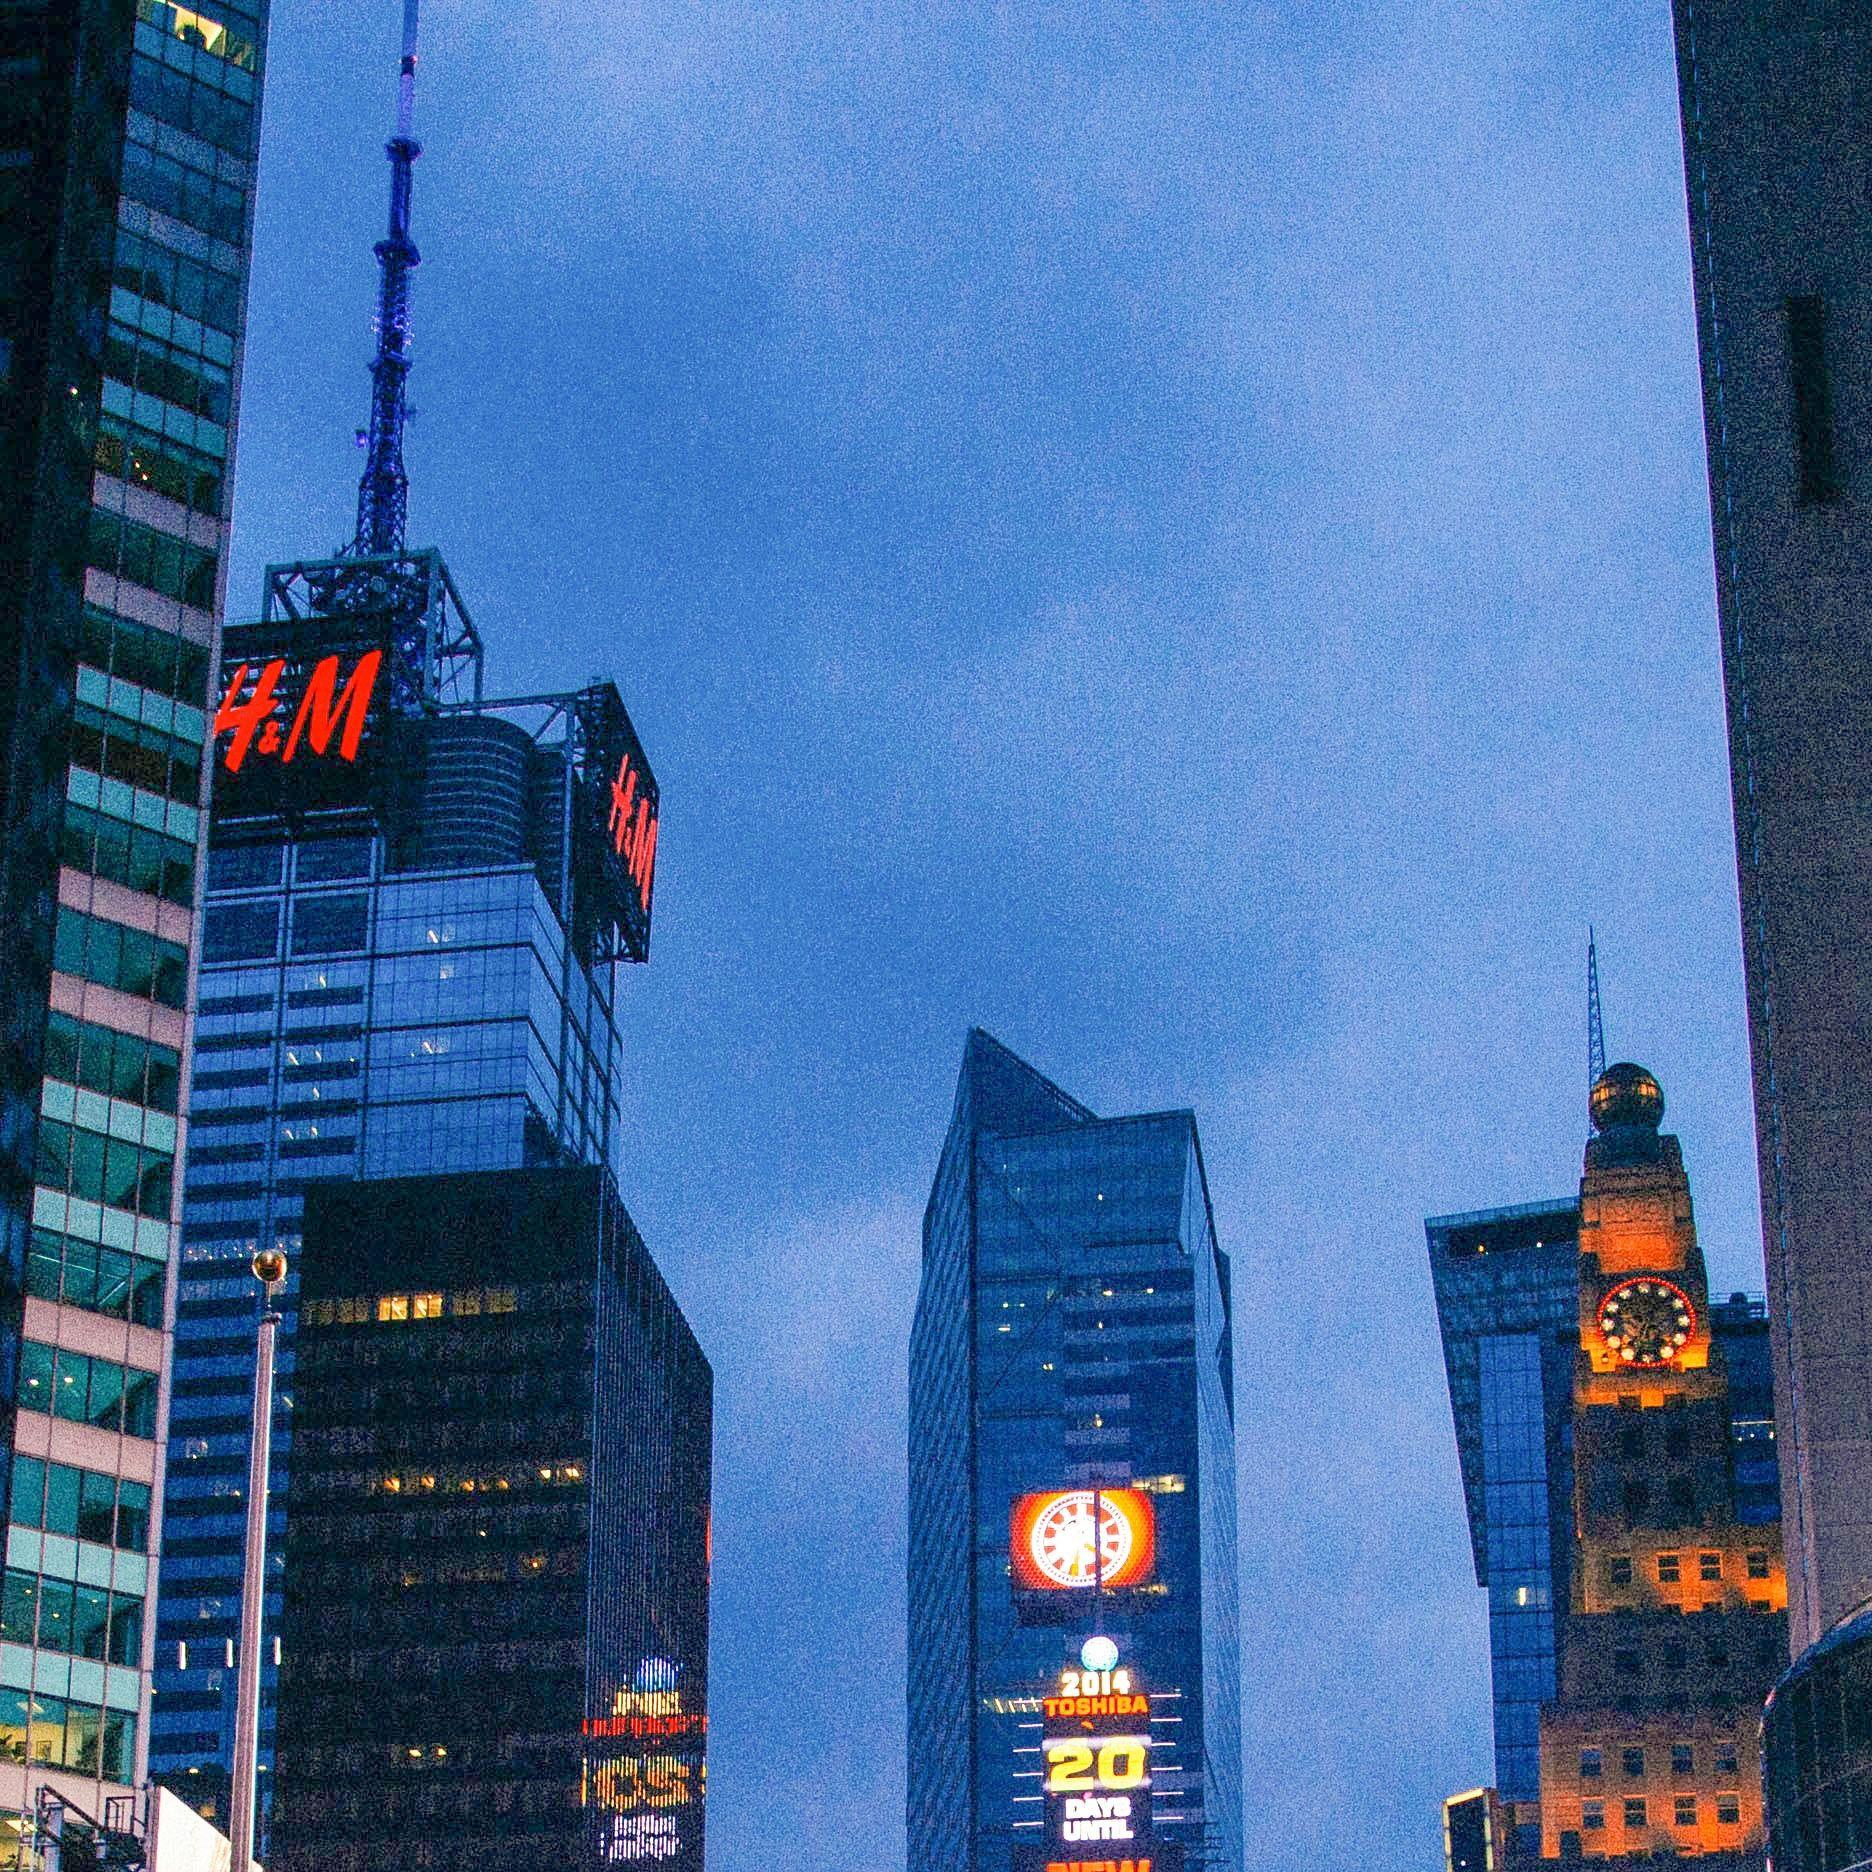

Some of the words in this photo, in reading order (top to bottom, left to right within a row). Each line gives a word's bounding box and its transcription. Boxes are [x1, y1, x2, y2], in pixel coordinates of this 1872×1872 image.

[213, 648, 383, 774] H&M
[608, 752, 658, 912] H&M
[1061, 1670, 1130, 1698] 2014
[1043, 1695, 1148, 1717] TOSHIBA
[1046, 1743, 1147, 1792] 20
[1065, 1797, 1131, 1821] DAYS
[1063, 1819, 1133, 1843] UNTIL
